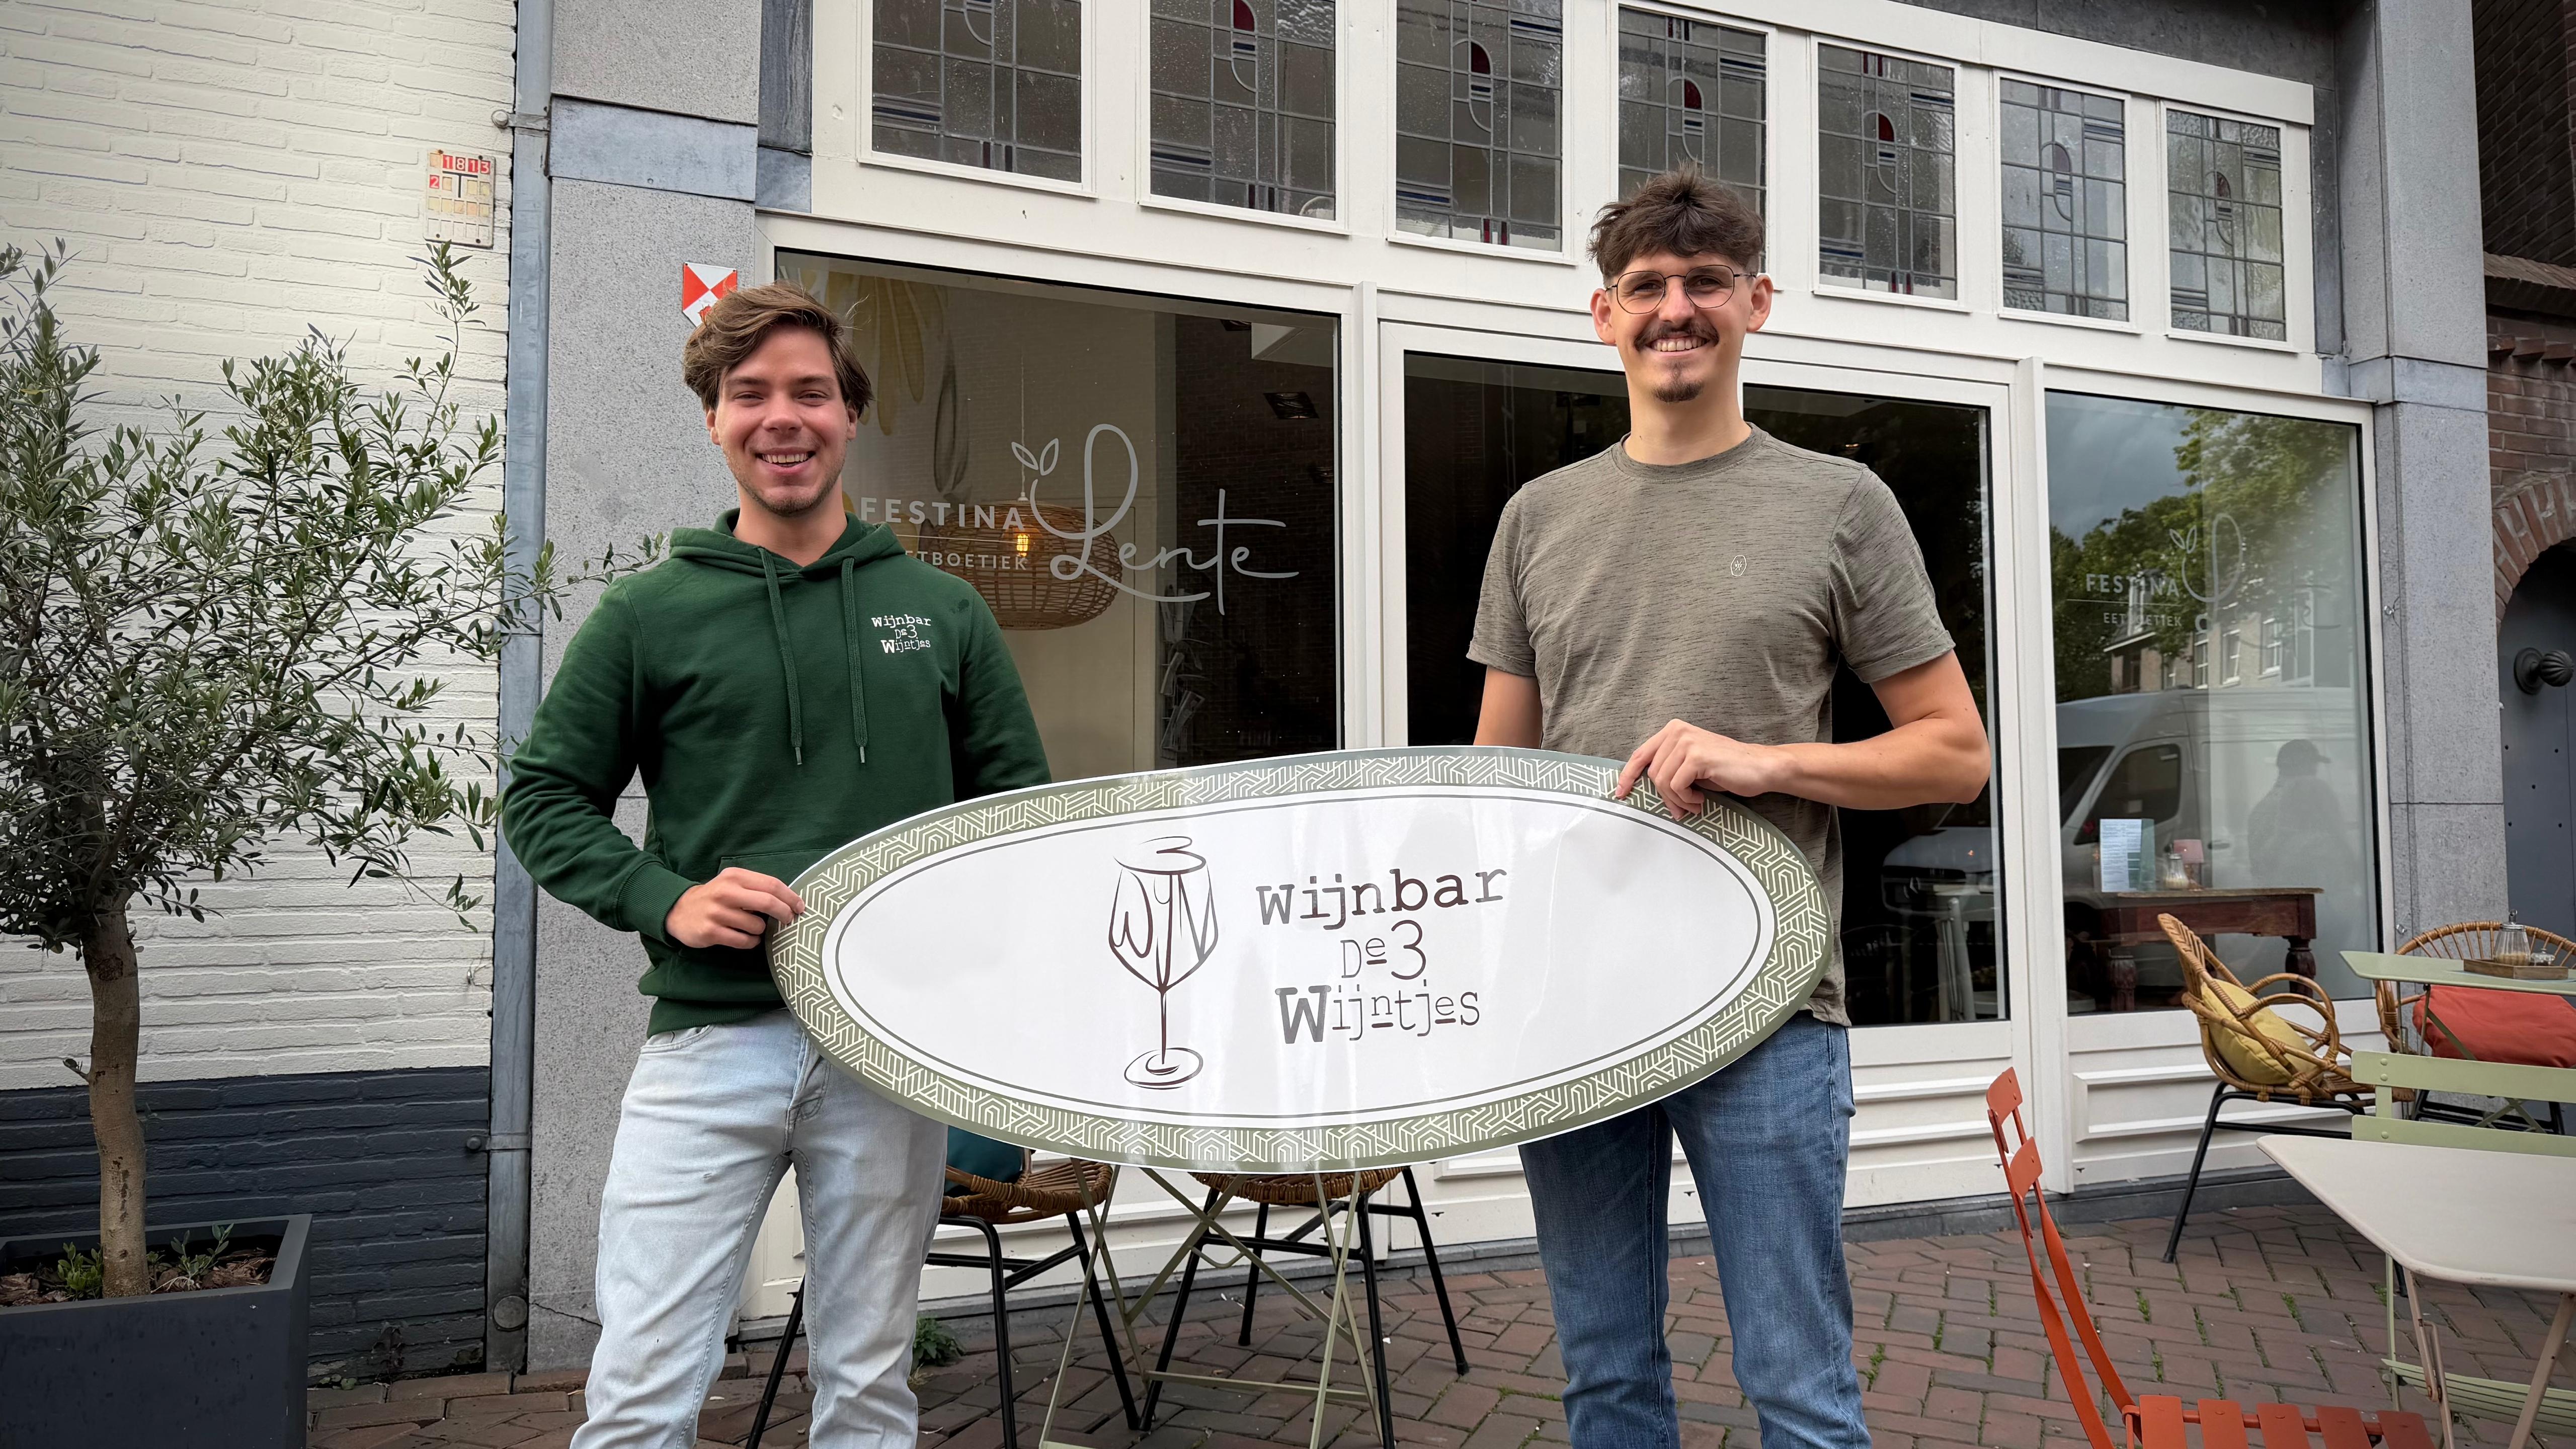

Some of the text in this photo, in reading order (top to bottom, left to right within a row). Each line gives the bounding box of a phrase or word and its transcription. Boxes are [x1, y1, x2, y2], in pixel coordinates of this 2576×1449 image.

[444, 156, 490, 174] 1813
[430, 176, 439, 188] 2
[860, 423, 1300, 615] FESTINA Lente
[905, 550, 1028, 571] TBOETIEK
[2086, 573, 2180, 597] FESTINA
[895, 624, 918, 638] De 3
[880, 637, 931, 654] Wijntjes
[1340, 919, 1426, 980] De 3
[1275, 979, 1481, 1044] Wijntjes
